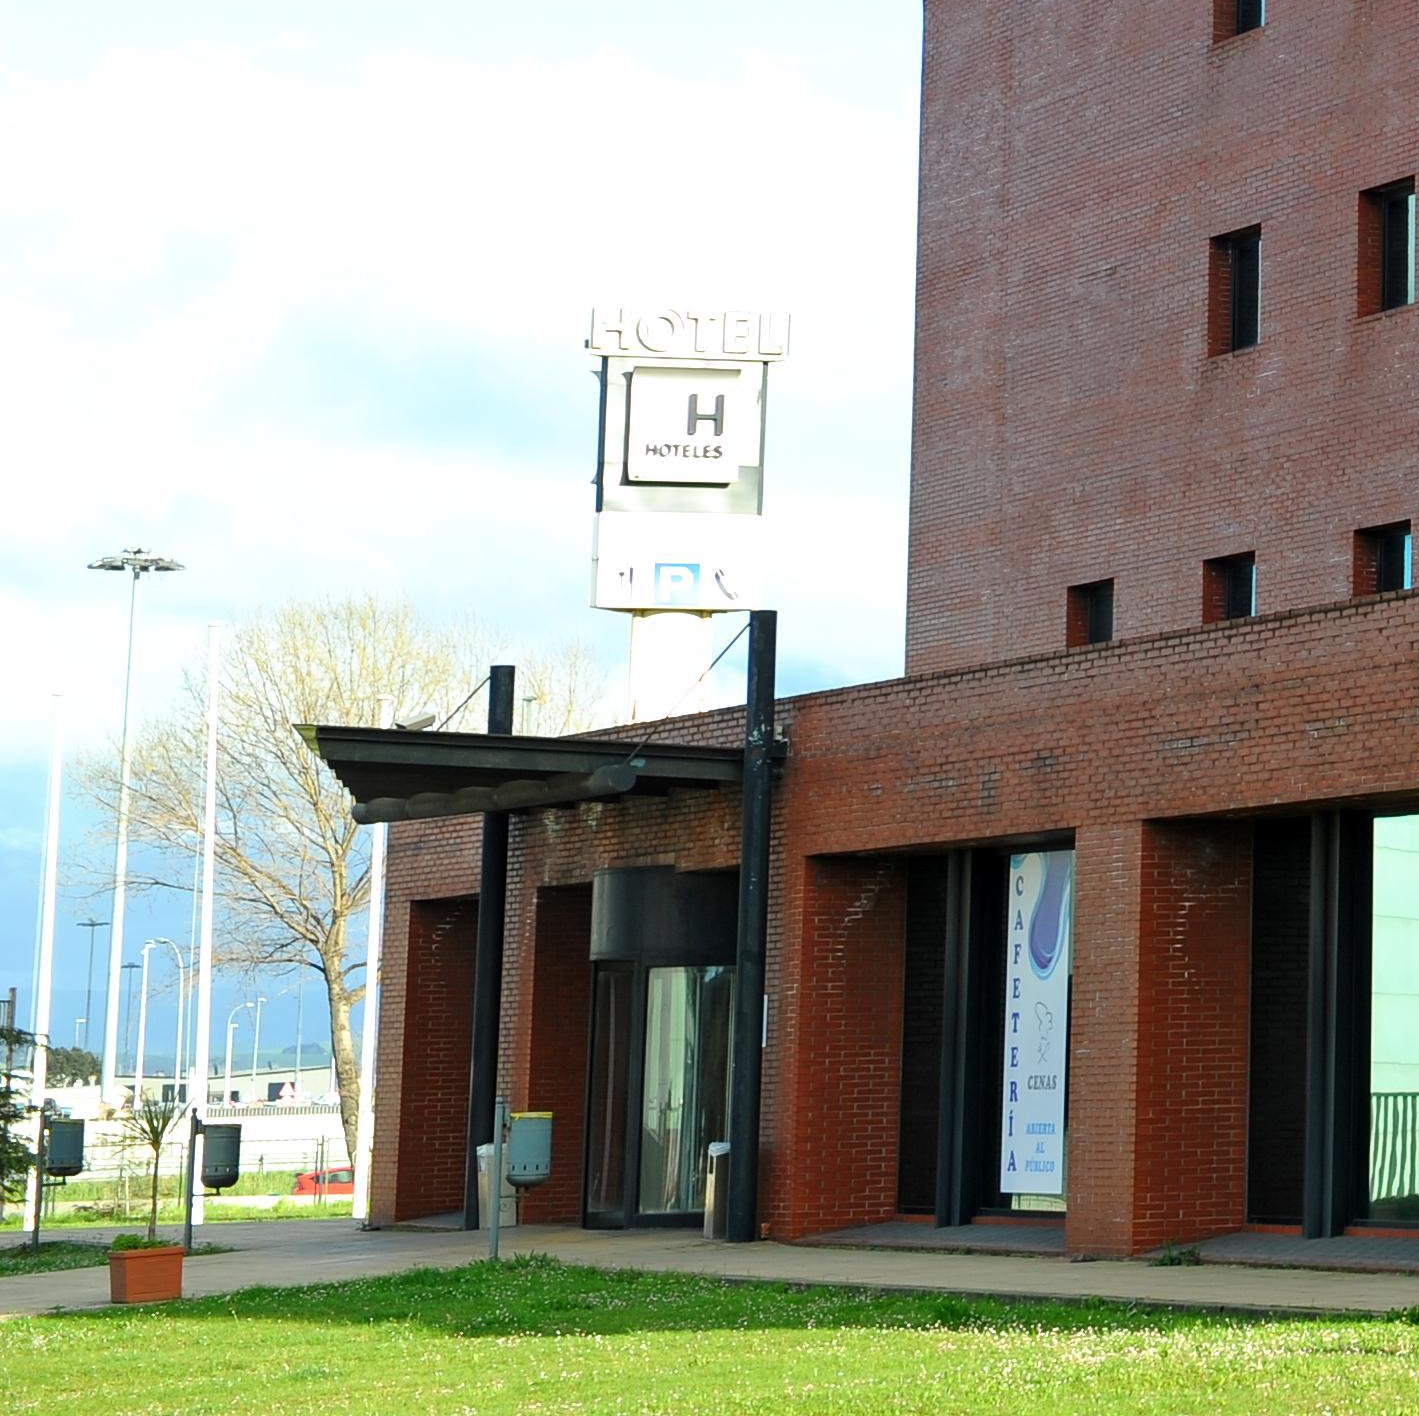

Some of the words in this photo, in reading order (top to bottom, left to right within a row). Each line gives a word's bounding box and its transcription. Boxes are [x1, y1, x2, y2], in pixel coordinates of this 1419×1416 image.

[590, 307, 787, 355] HOTEL
[687, 393, 725, 436] H
[645, 444, 723, 459] HOTELES
[658, 565, 695, 604] P
[1027, 1074, 1057, 1090] CENAS
[1036, 1142, 1045, 1154] AL
